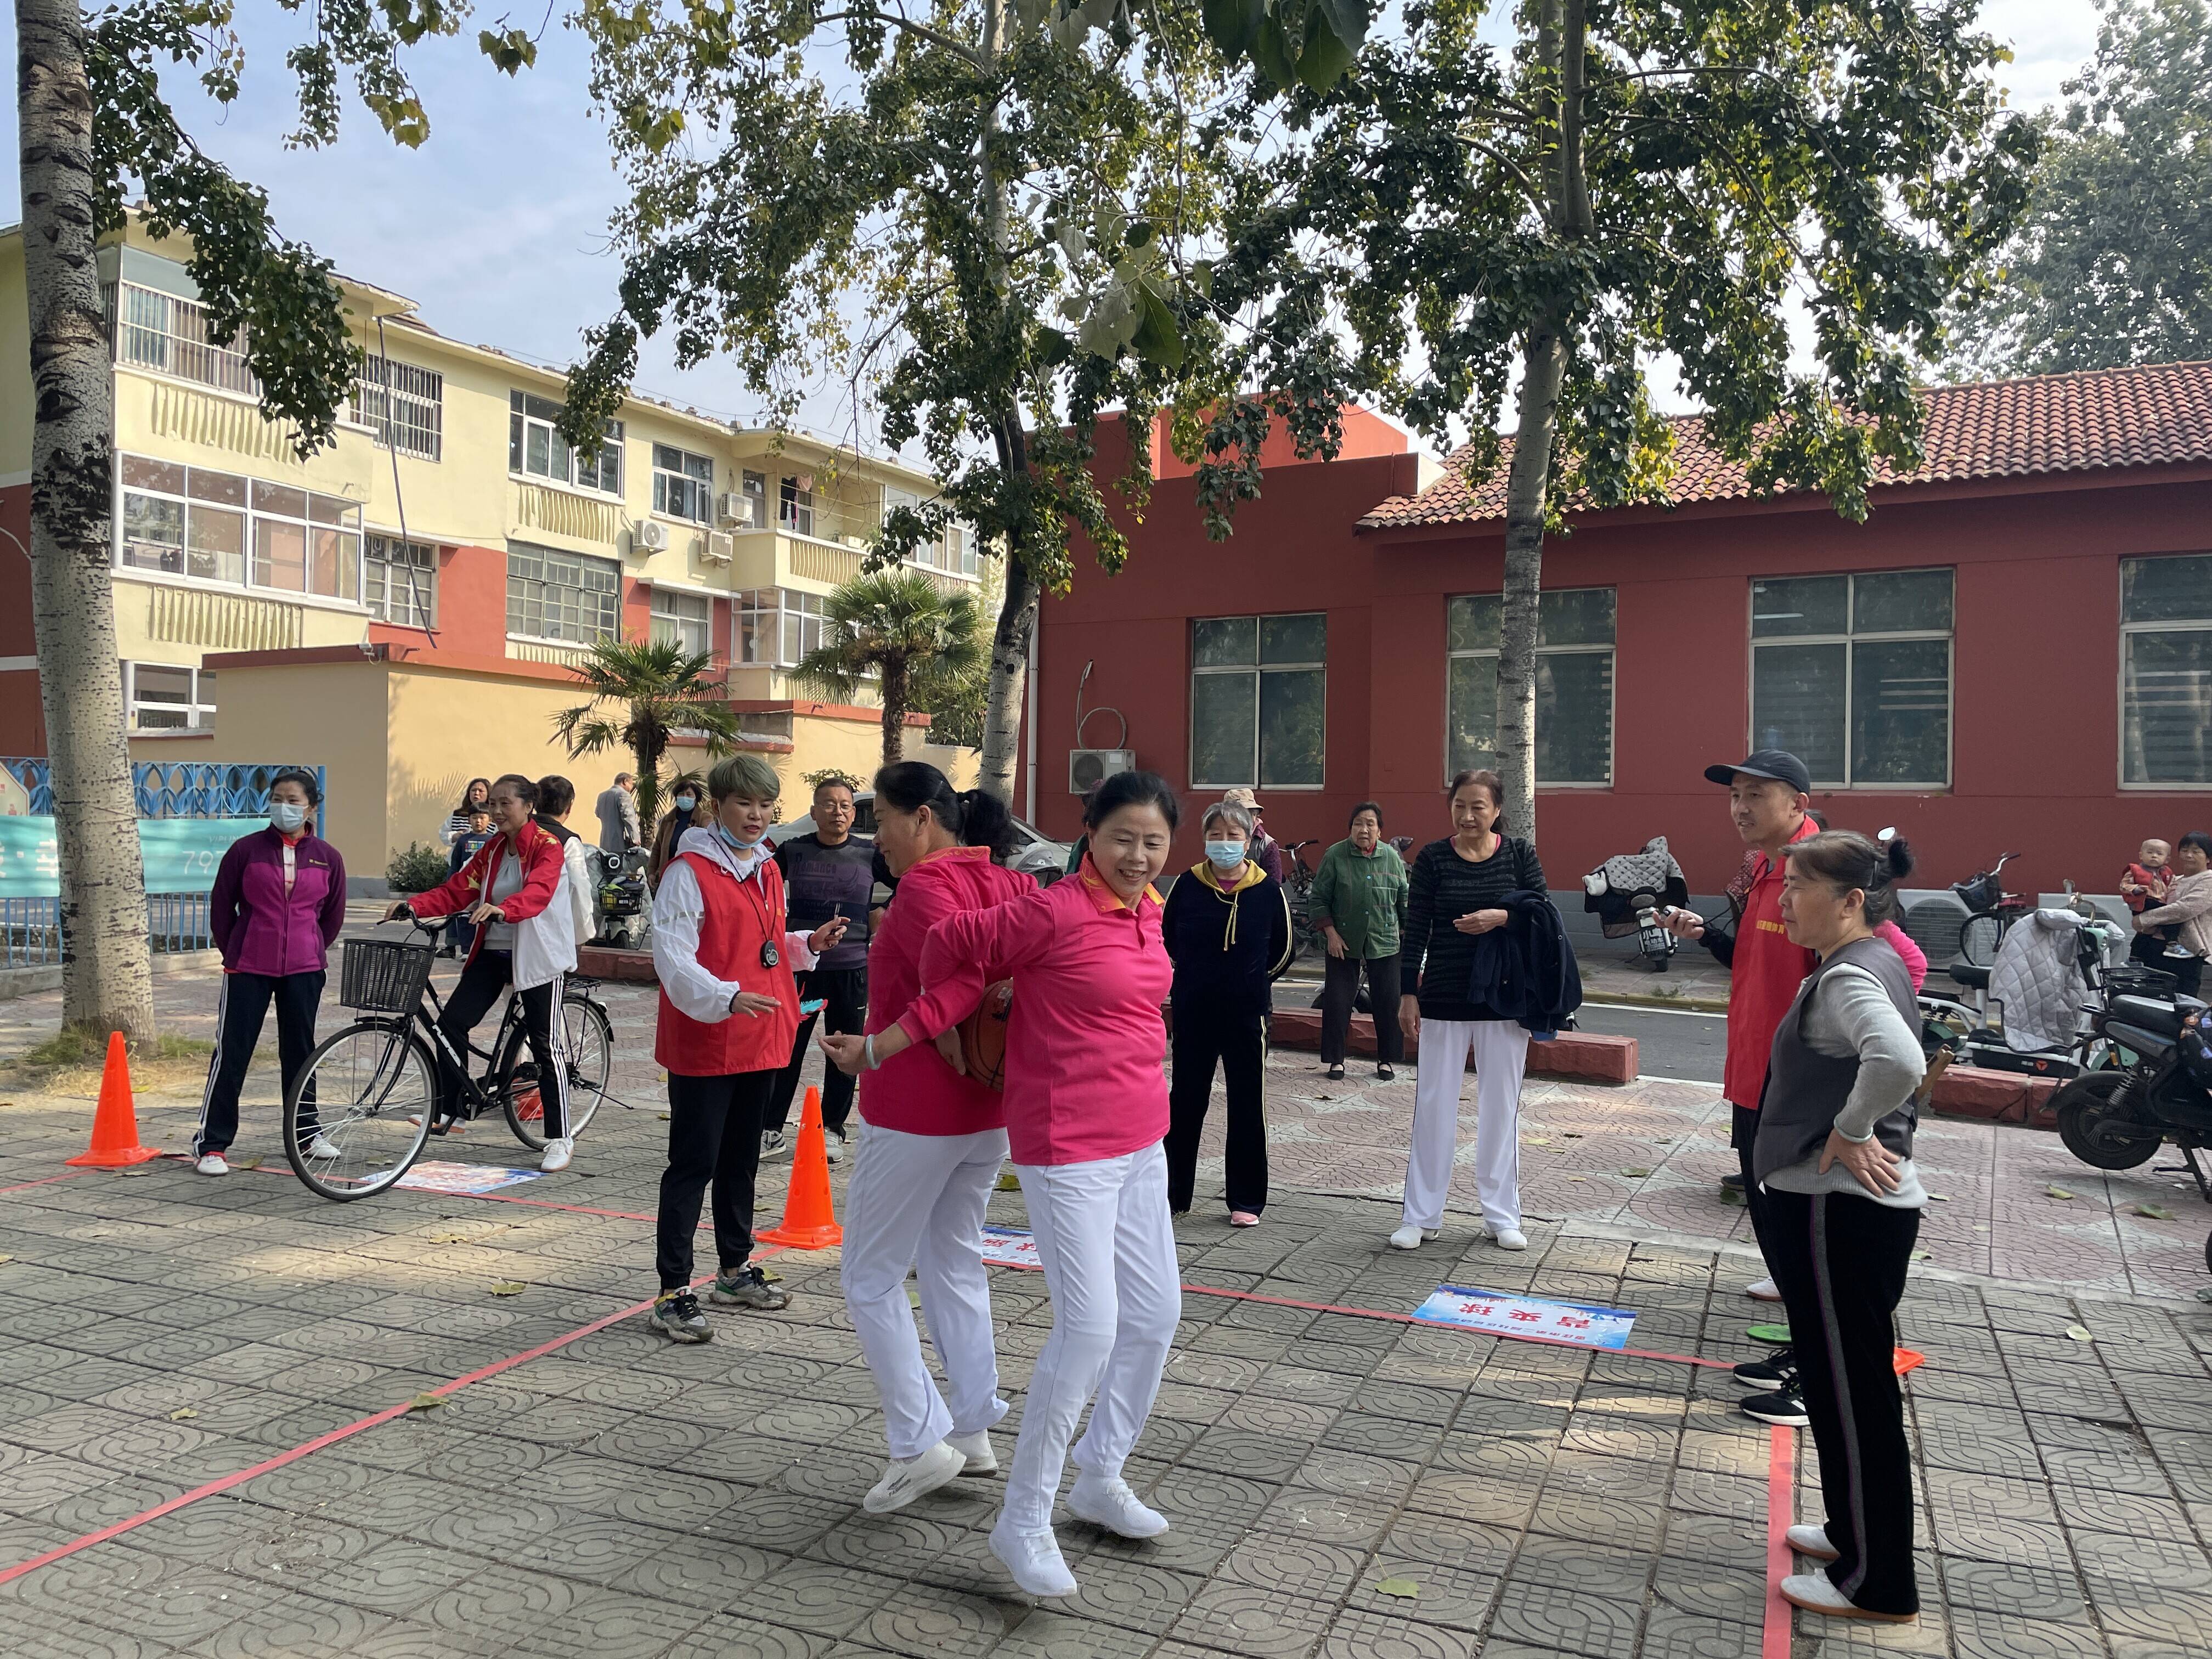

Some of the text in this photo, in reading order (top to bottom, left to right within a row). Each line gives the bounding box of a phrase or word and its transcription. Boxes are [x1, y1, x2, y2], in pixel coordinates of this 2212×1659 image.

[182, 850, 226, 874] 79
[1459, 1303, 1591, 1329] 背夹球
